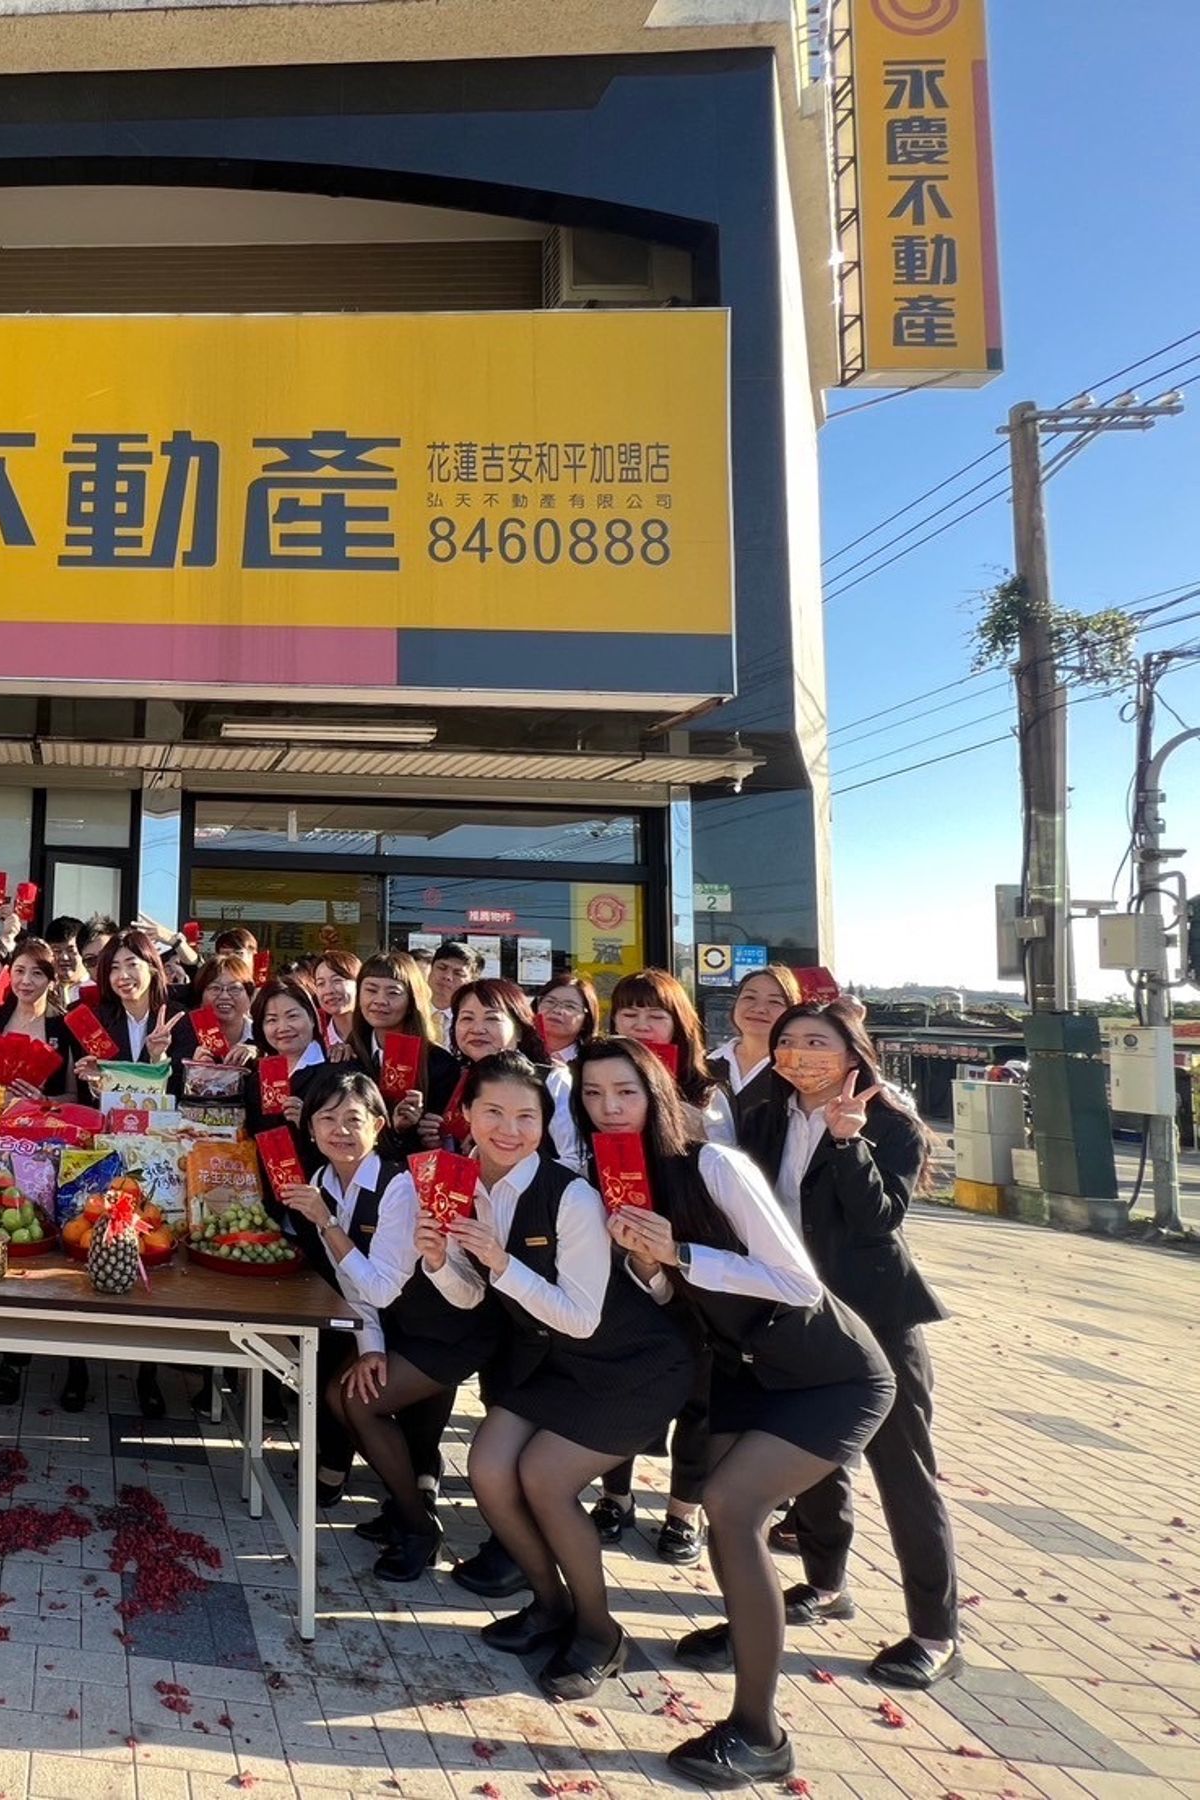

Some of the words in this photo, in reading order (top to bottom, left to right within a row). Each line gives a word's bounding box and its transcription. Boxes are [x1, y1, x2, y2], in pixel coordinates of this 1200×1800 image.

[883, 58, 958, 348] 永慶不動產
[426, 441, 670, 484] 花蓮吉安和平加盟店
[427, 492, 673, 510] 弘天不動產有限公司
[427, 515, 672, 567] 8460888
[706, 896, 717, 911] 2
